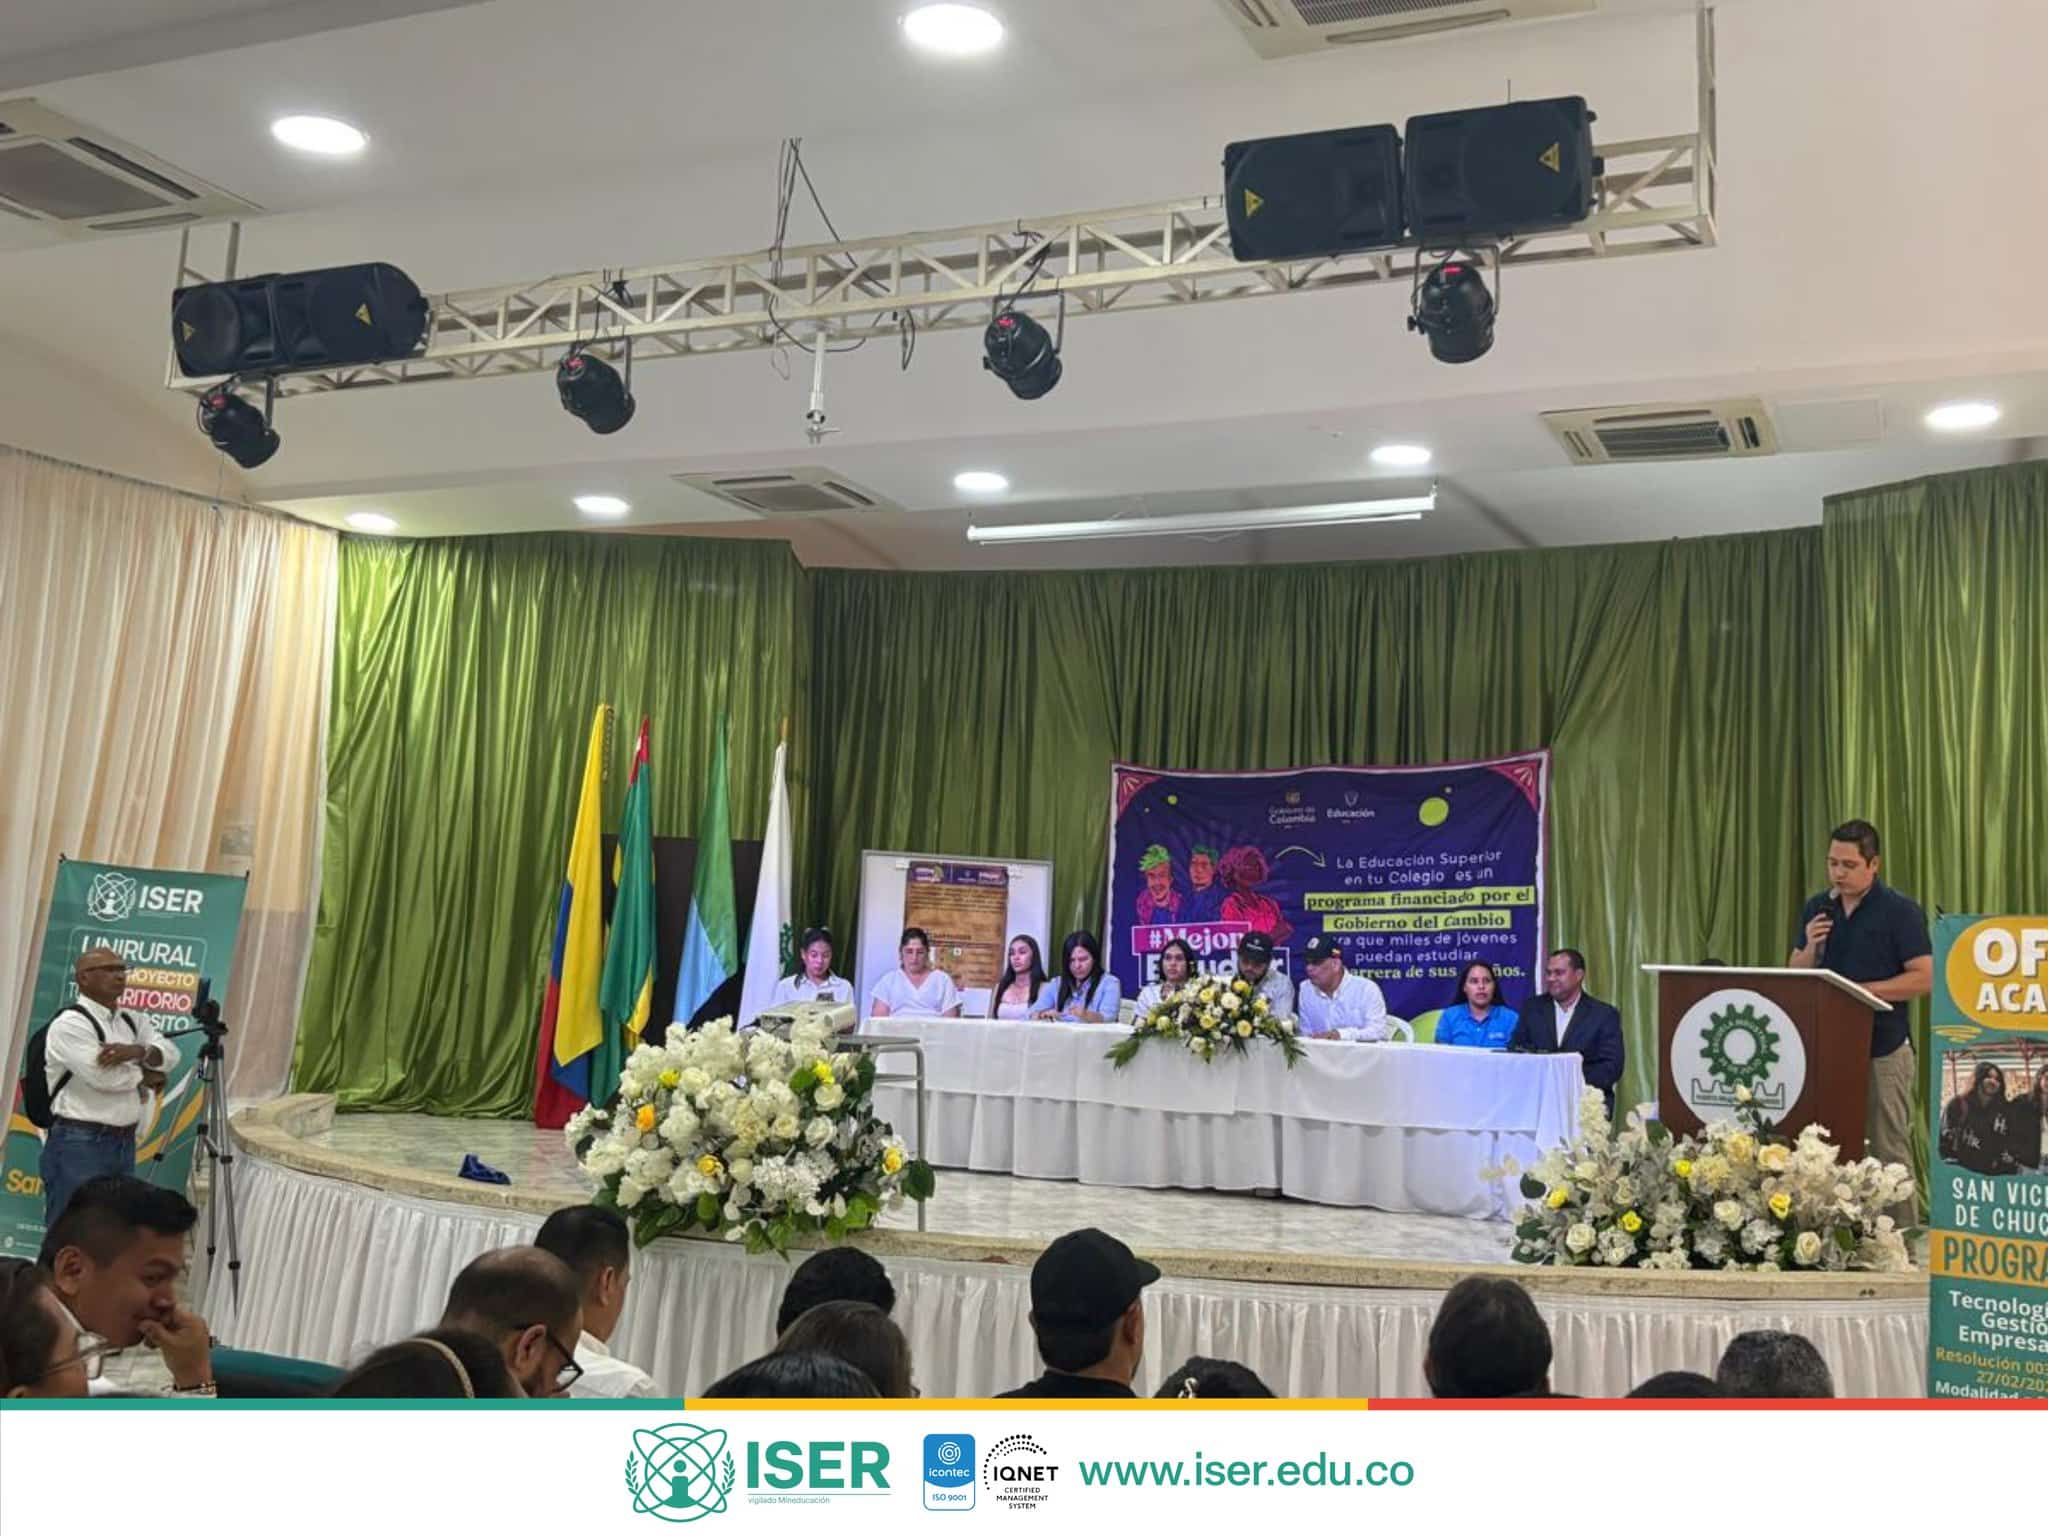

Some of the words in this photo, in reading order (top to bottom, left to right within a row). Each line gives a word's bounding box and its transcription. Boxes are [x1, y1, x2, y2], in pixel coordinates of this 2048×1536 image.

[1326, 807, 1376, 818] Educación
[1337, 857, 1354, 869] La
[1359, 852, 1434, 869] Educación
[1439, 849, 1502, 867] Superior
[1344, 875, 1362, 886] en
[1367, 873, 1384, 885] tu
[1388, 870, 1445, 886] Colegio
[1455, 871, 1472, 881] es
[138, 885, 205, 915] ISER
[1306, 894, 1385, 912] programa
[1391, 890, 1475, 907] financiado
[1481, 890, 1511, 905] por
[1516, 888, 1529, 901] el
[1333, 914, 1407, 930] Gobierno
[1412, 913, 1438, 929] del
[1444, 911, 1505, 928] Cambio
[1356, 935, 1384, 949] que
[1390, 933, 1431, 946] miles
[1434, 931, 1451, 944] de
[1456, 931, 1518, 947] jóvenes
[1355, 949, 1412, 966] puedan
[1417, 949, 1479, 962] estudiar
[1350, 966, 1401, 979] arrera
[1405, 964, 1424, 977] de
[1428, 966, 1457, 977] sus
[1493, 963, 1526, 977] ños.
[1952, 1177, 1995, 1202] SAN
[1956, 1204, 1980, 1228] DE
[1992, 1208, 2048, 1237] CHUC
[1959, 1326, 2048, 1353] Empresa
[1936, 1347, 2020, 1371] Resolución
